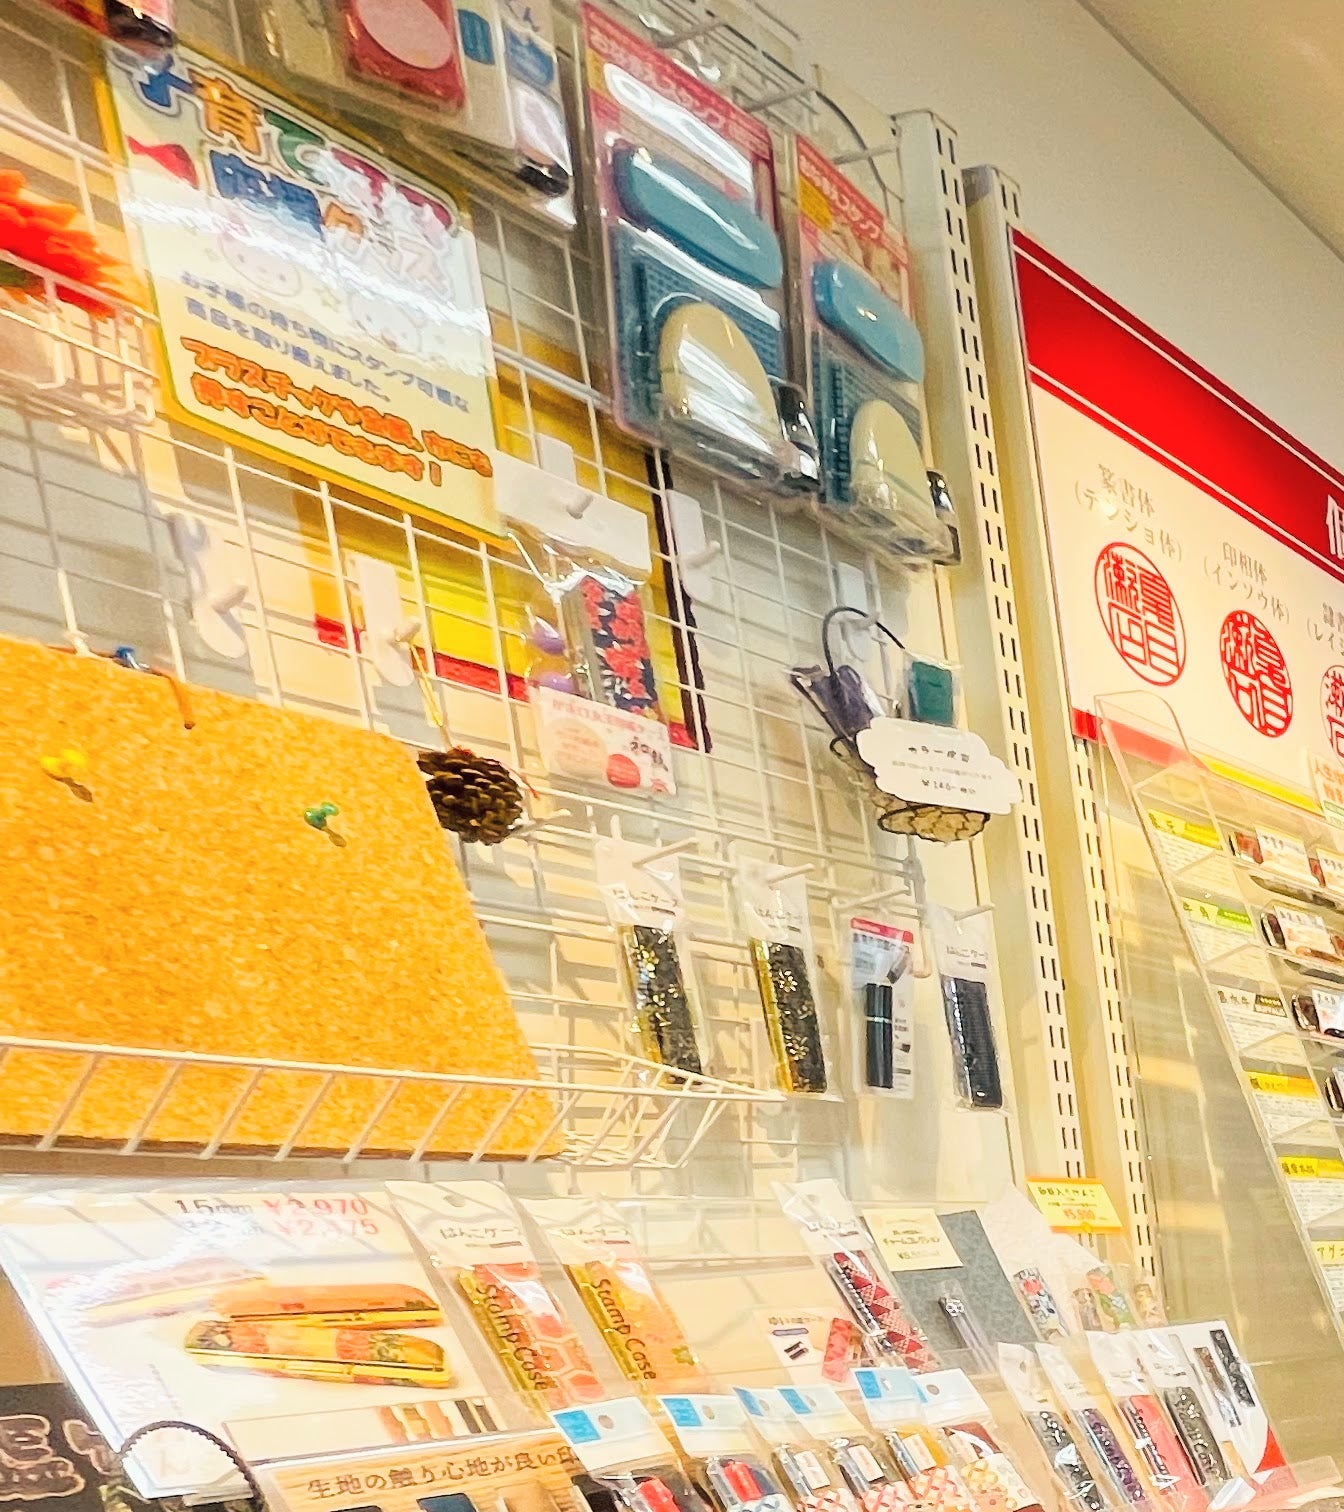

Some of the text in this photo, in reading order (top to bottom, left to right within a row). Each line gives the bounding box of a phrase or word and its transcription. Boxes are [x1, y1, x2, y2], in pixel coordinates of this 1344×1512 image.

[1221, 542, 1267, 586] 印相体
[473, 1282, 553, 1392] Stamp Case
[596, 1277, 657, 1382] Stamp Case
